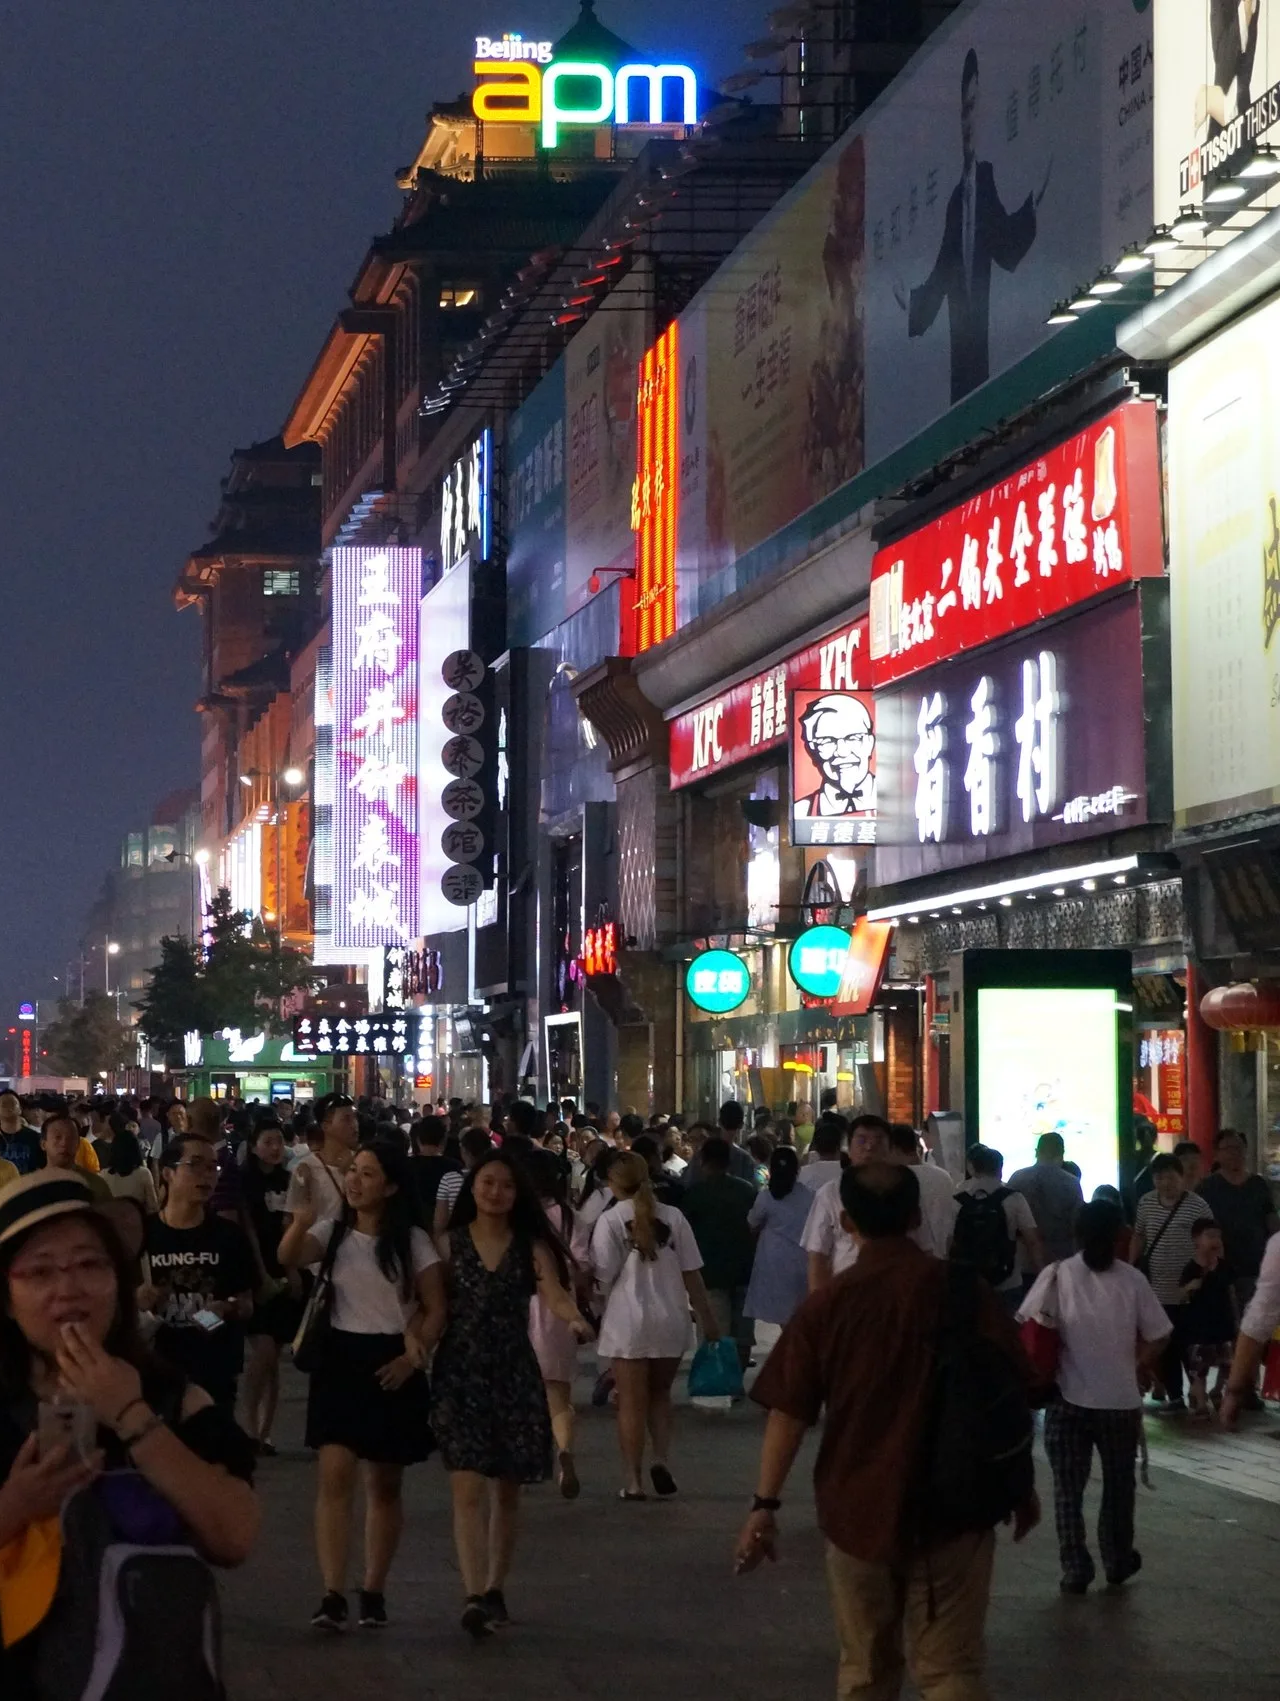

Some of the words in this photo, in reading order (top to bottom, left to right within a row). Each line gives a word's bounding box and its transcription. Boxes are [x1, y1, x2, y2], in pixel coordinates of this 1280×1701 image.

[475, 33, 553, 63] Beijing
[472, 61, 698, 148] apm
[1201, 115, 1244, 176] TISSOT
[1245, 97, 1267, 141] THIS
[1269, 87, 1279, 124] IS
[820, 627, 862, 690] KFC
[691, 702, 724, 772] KFC
[750, 670, 787, 747] 肯德基
[447, 650, 482, 852] 吴裕泰茶馆
[914, 651, 1061, 843] 稻香村
[810, 821, 877, 843] 肯德基
[452, 888, 476, 900] 2F
[151, 1251, 220, 1267] KUNG-FU
